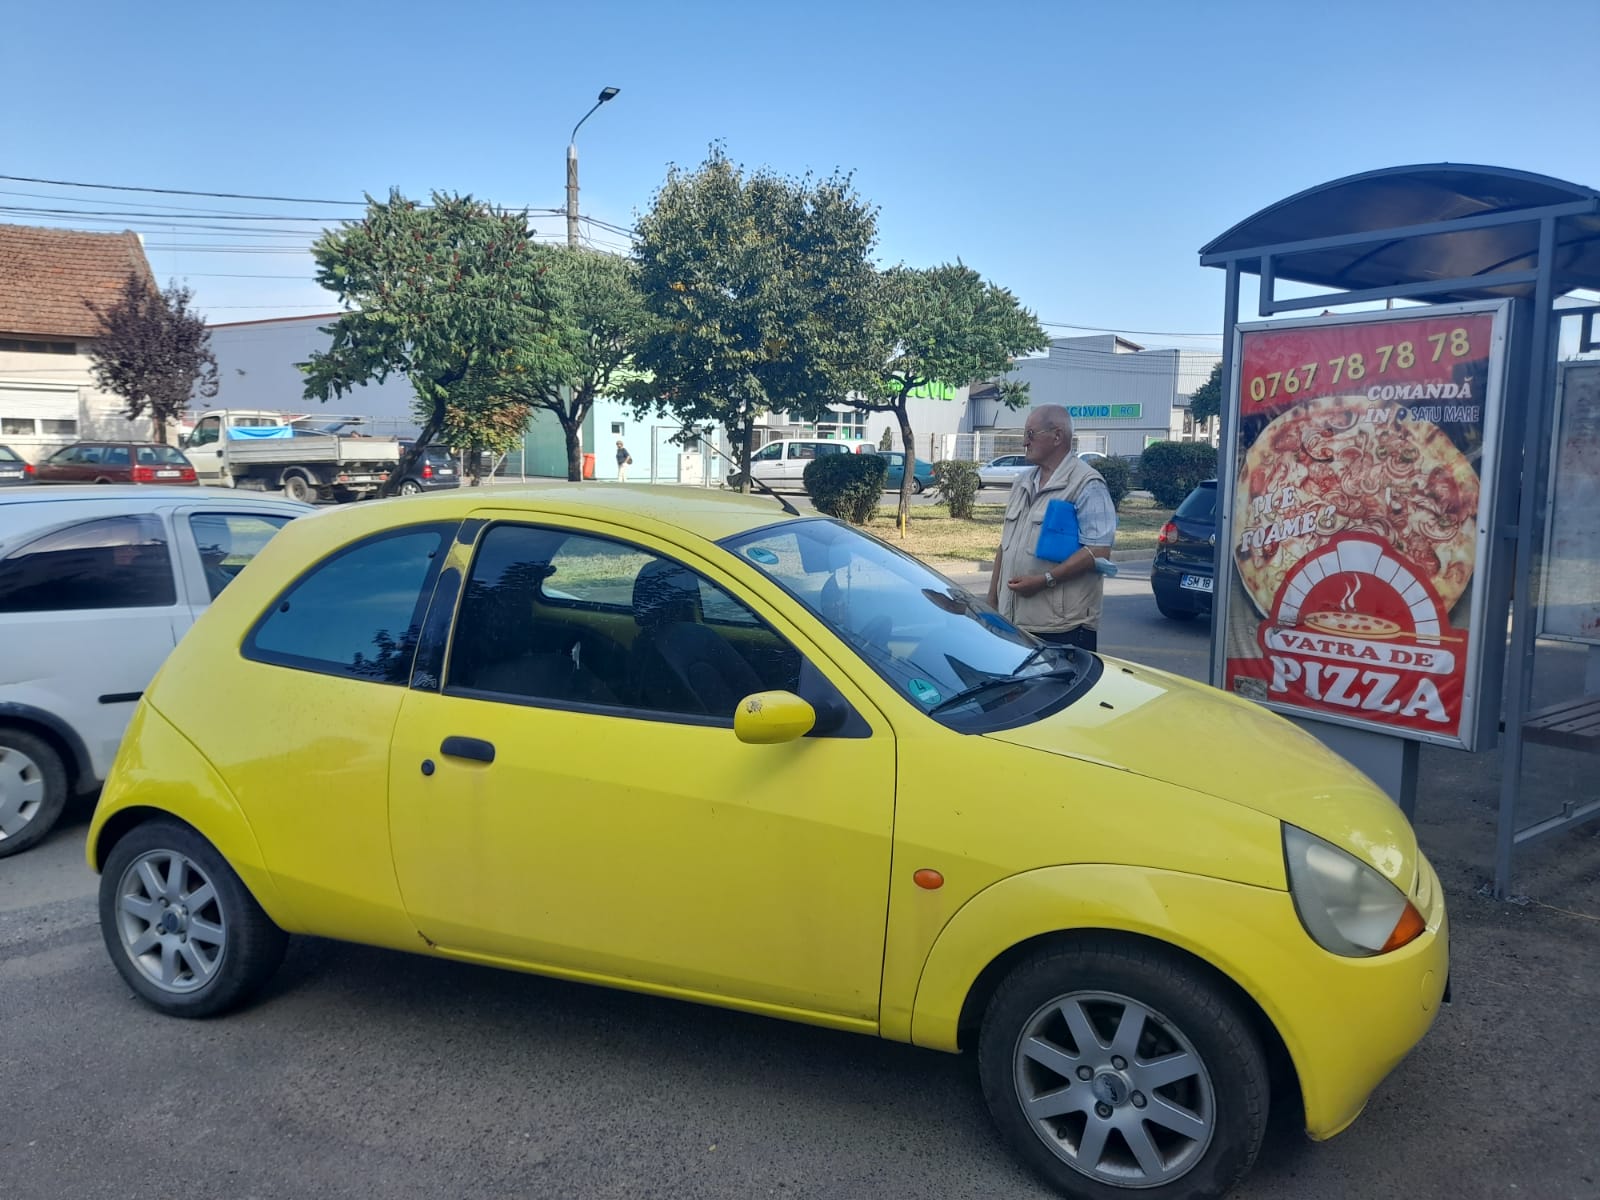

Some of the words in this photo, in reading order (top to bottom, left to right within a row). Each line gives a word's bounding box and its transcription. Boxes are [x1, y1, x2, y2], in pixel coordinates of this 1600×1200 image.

[1250, 362, 1318, 402] 0767
[1329, 353, 1366, 384] 78
[1375, 341, 1415, 373] 78
[1428, 328, 1470, 362] 78
[1367, 376, 1473, 400] COMANDĂ
[1411, 406, 1442, 423] SATU
[1443, 406, 1480, 423] MARE
[1240, 510, 1317, 552] FOAME
[1280, 633, 1381, 662] VATRA
[1390, 650, 1436, 669] DE
[1270, 656, 1450, 722] PIZZA
